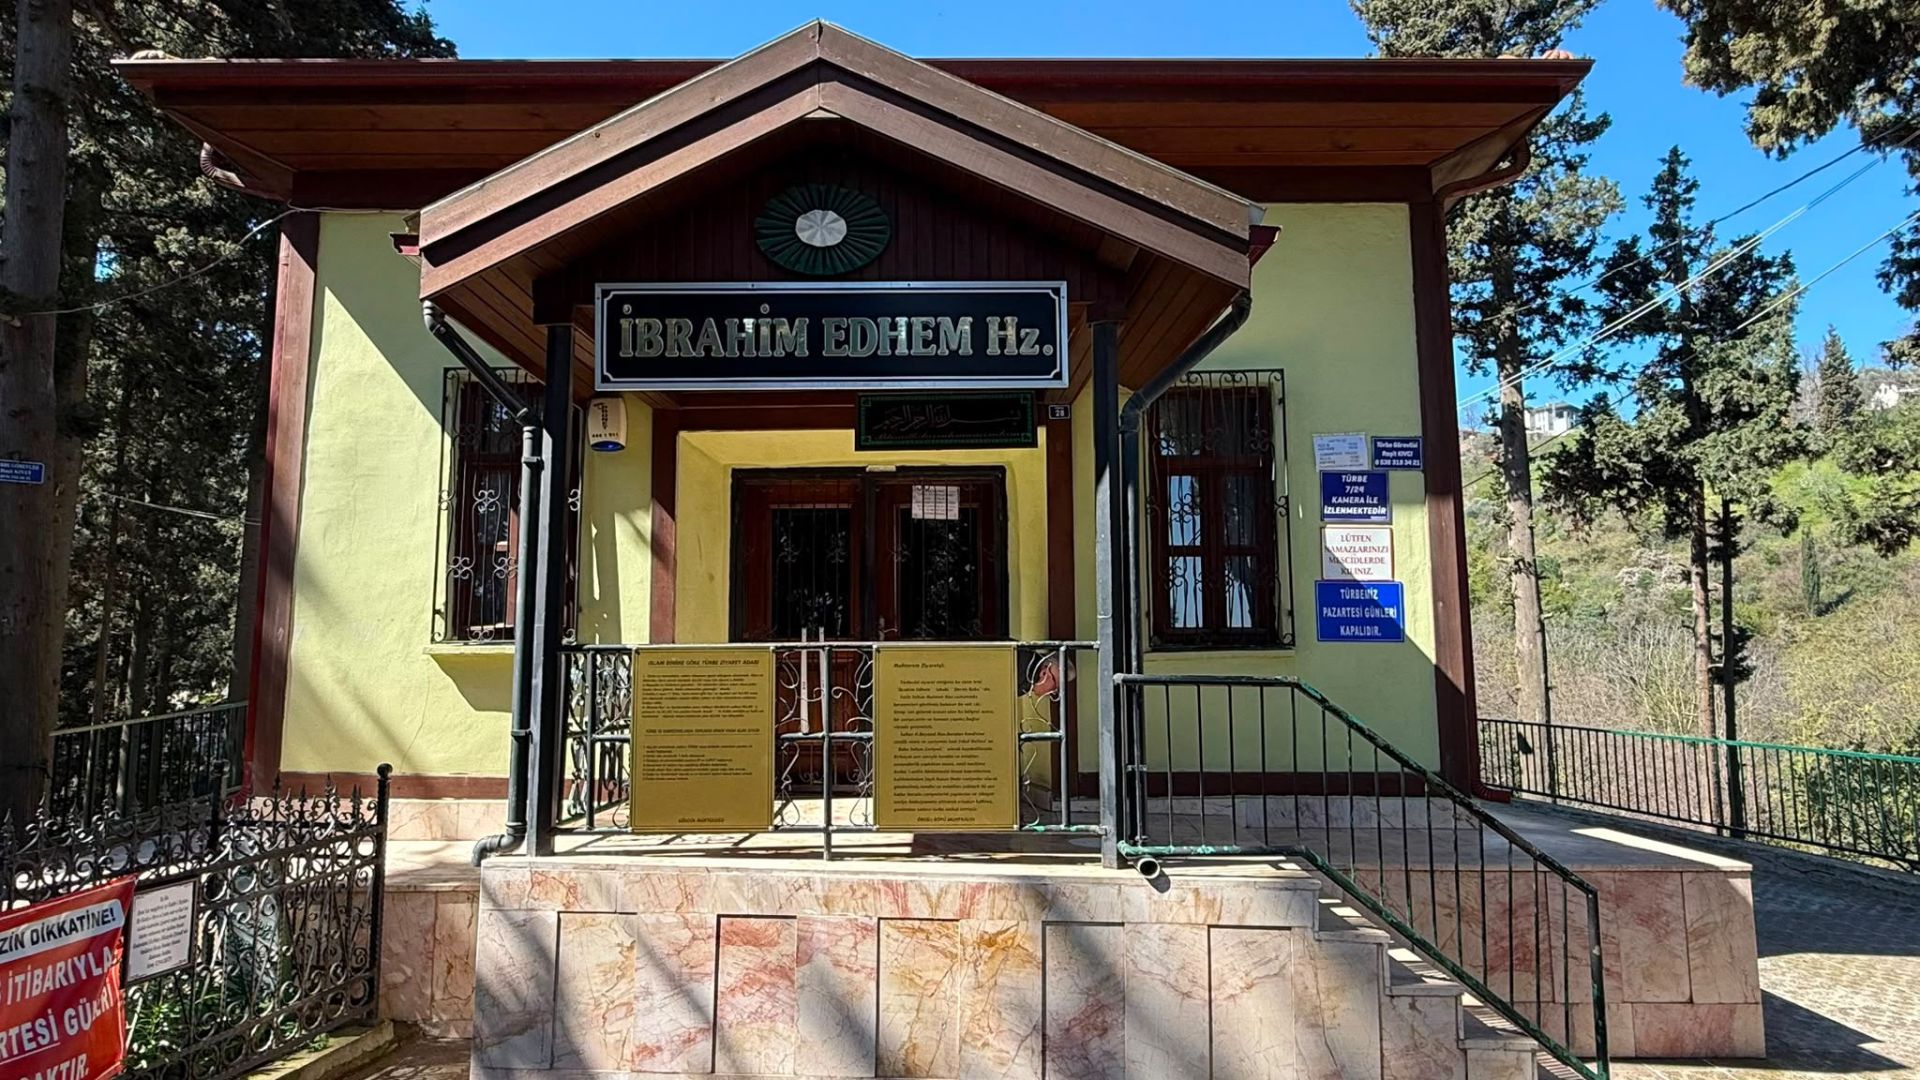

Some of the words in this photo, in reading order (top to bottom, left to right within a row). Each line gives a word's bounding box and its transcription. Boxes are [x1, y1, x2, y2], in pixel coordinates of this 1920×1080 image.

[619, 303, 810, 357] İBRAHİM
[822, 315, 974, 357] EDHEM
[986, 315, 1054, 356] Hz.
[1341, 474, 1368, 483] TÜRBE
[1345, 485, 1365, 494] 7/24
[1331, 496, 1365, 504] KAMERA
[1366, 495, 1379, 504] İLE
[1324, 505, 1387, 515] İZLENMEKTEDİR
[1340, 533, 1372, 542] LÜTFEN
[1340, 586, 1379, 600] TÜRBEMİZ
[1322, 605, 1363, 618] PAZARTESİ
[1364, 604, 1398, 619] GÜNLERİ
[1340, 625, 1382, 637] KAPALIDIR.
[30, 907, 117, 947] DİKKATİNE!
[7, 945, 114, 1006] İTİBARIYLA
